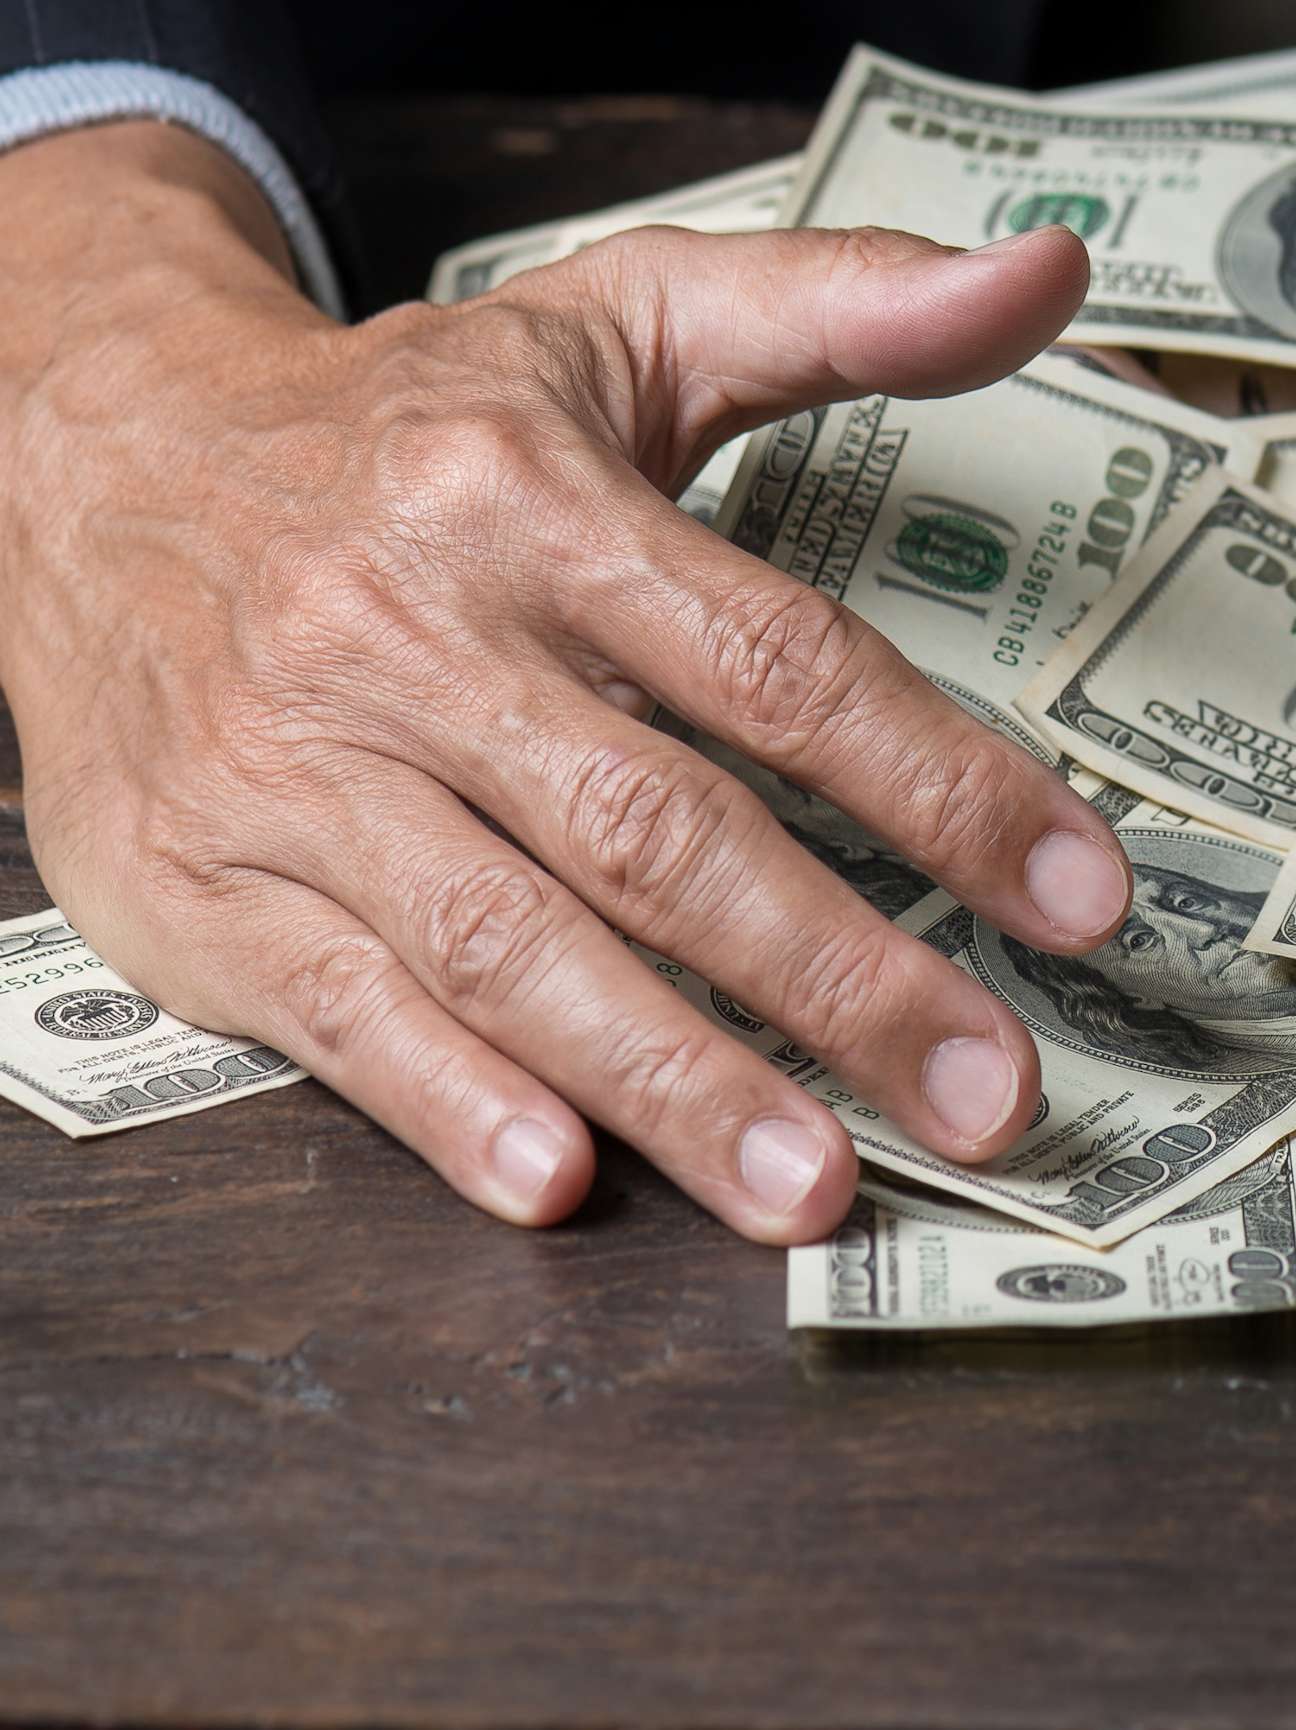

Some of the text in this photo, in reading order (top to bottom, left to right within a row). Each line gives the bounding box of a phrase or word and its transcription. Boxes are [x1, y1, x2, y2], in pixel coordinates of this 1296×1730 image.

[1076, 446, 1154, 583] 100
[142, 1034, 173, 1049] LEGAL
[97, 1045, 291, 1112] 100
[1080, 1097, 1113, 1123] TENDER
[1101, 1089, 1136, 1119] PRIVATE
[1172, 1091, 1203, 1114] SERIES
[1065, 1122, 1217, 1213] 100
